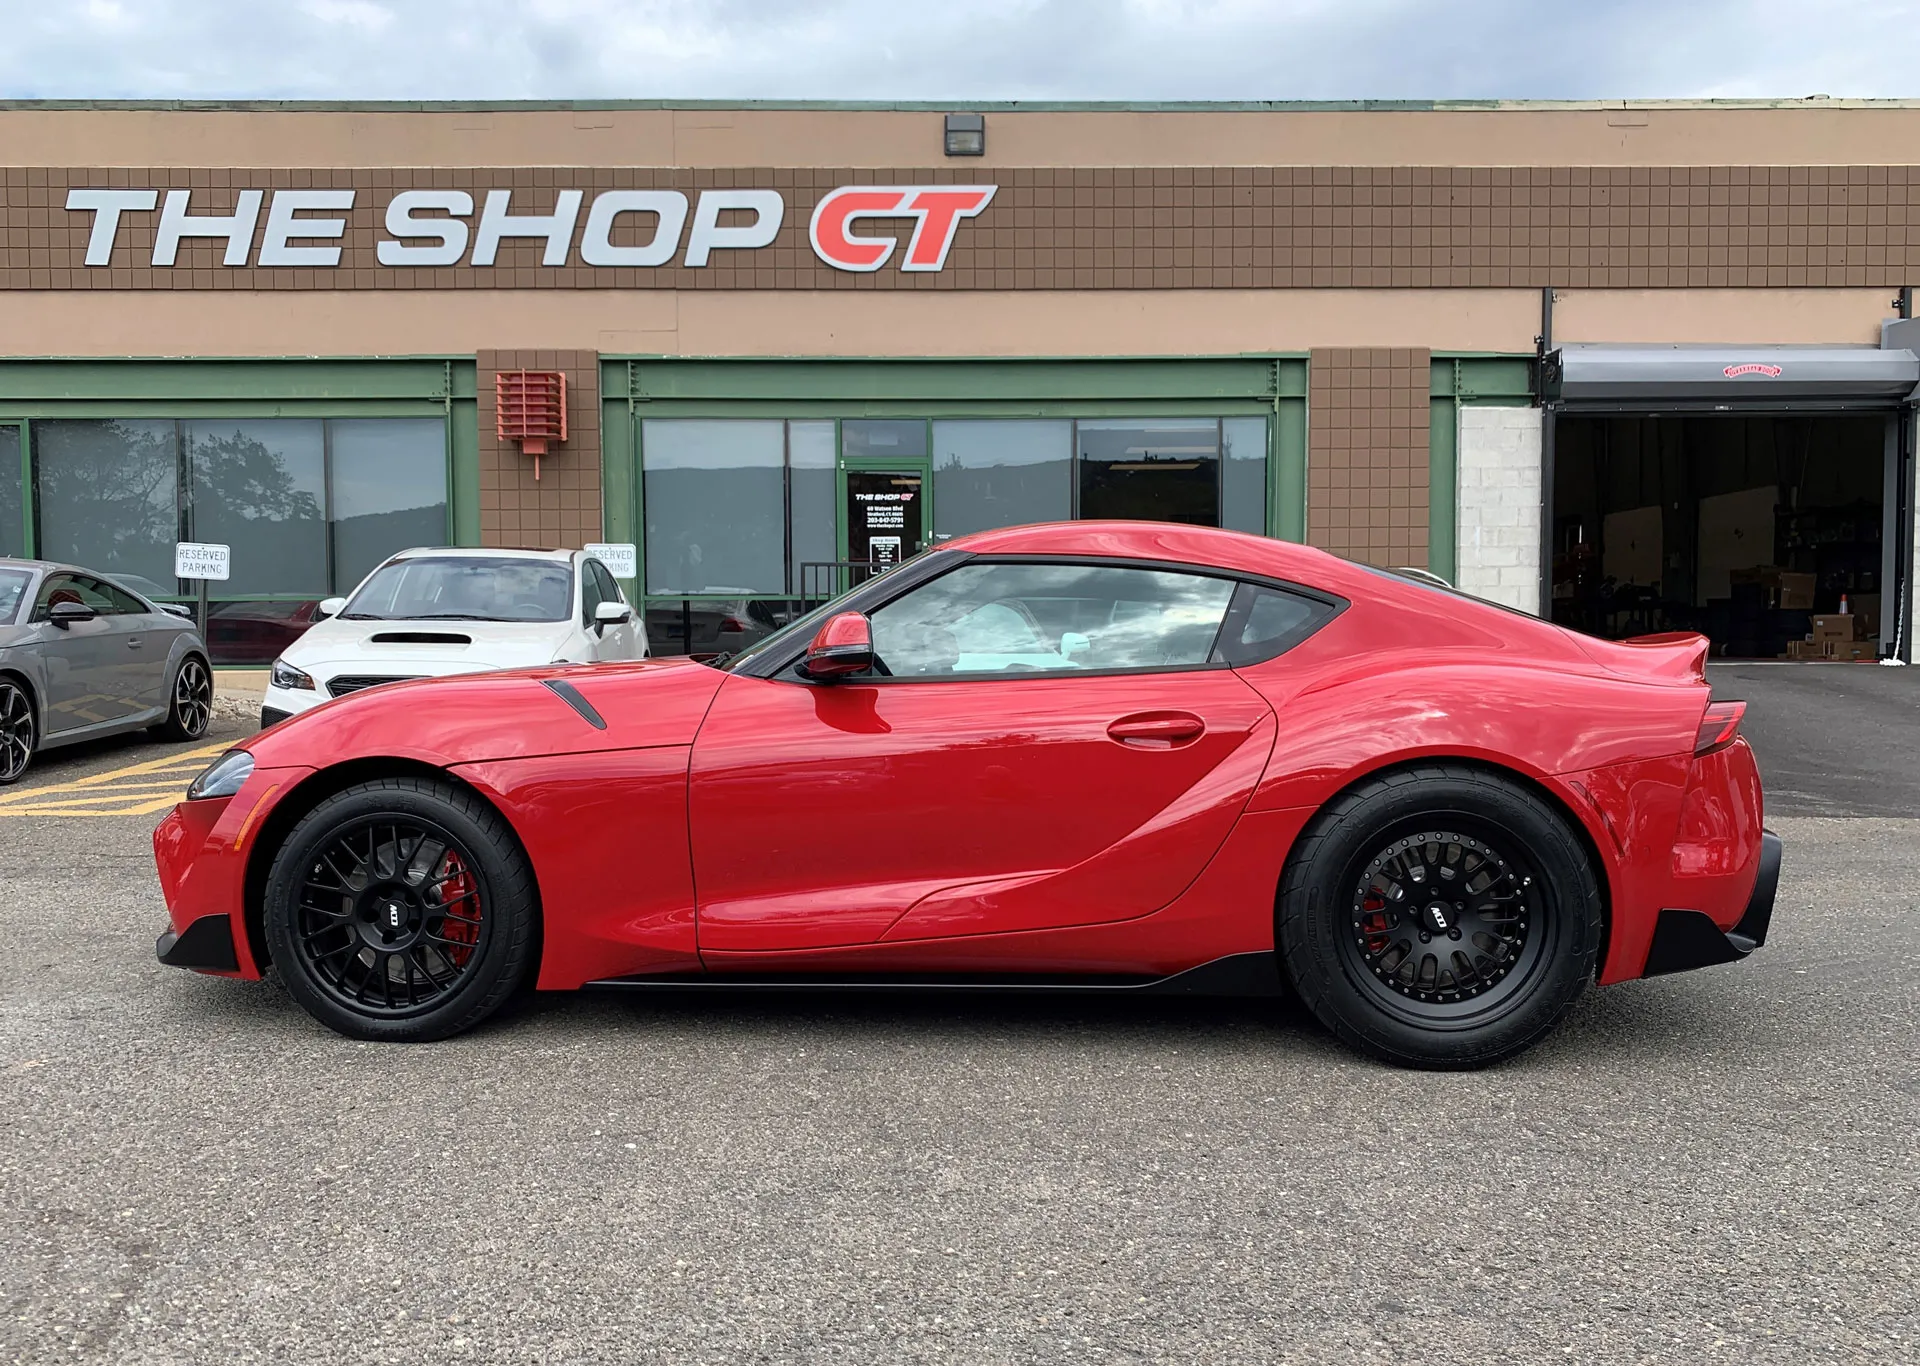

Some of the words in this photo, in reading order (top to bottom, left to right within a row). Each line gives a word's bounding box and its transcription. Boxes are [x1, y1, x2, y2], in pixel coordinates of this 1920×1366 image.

[64, 188, 356, 267] THE
[376, 188, 785, 268] SHOP
[809, 184, 999, 272] CT
[855, 493, 874, 501] THE
[874, 493, 901, 501] SHOP
[179, 549, 226, 561] RESERVED
[182, 562, 222, 574] PARKING
